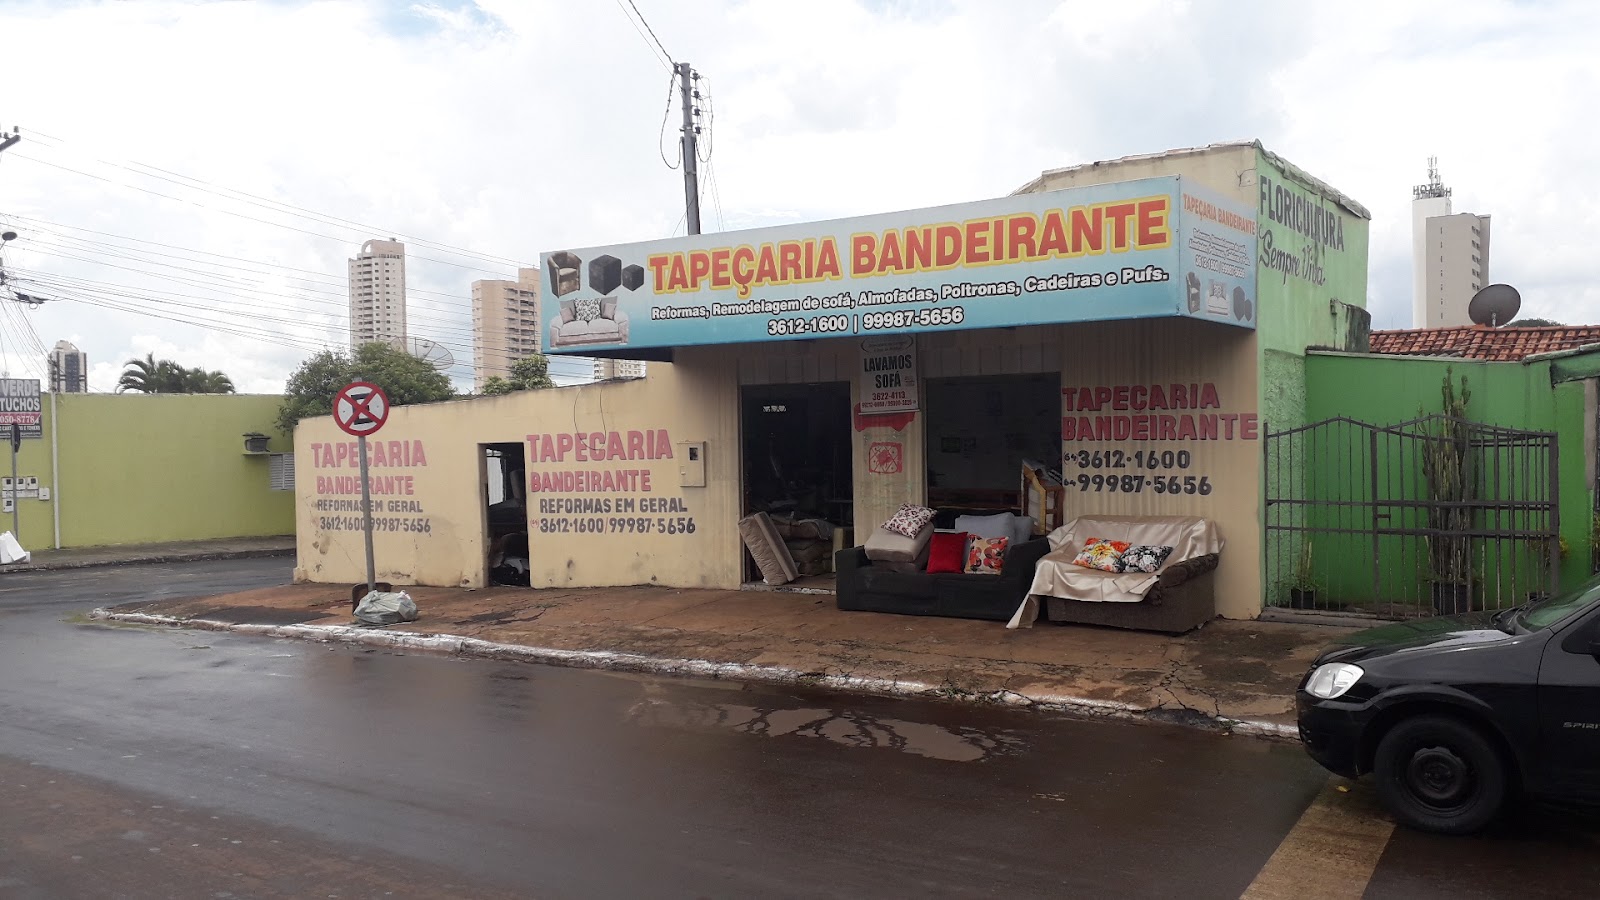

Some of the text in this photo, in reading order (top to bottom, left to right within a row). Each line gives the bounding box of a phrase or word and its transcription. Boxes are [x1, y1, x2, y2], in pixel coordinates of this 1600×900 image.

[1183, 193, 1256, 236] TAPEÇARIA BANDEIRANTE
[1260, 175, 1344, 251] FLORICULTURA
[649, 196, 1169, 298] TAPEÇARIA BANDEIRANTE
[1259, 224, 1300, 285] Sempre
[651, 265, 1169, 320] Reformas, Remodelagem de sofá, Almofadas, Poltronas, Cadeiras e Pufs.
[768, 314, 848, 336] 3612-1600
[863, 305, 964, 331] 99987-5656
[863, 354, 912, 372] LAVAMOS
[1, 380, 39, 396] VERDE
[875, 370, 902, 388] SOFÁ
[0, 397, 40, 412] TUCHOS
[1062, 383, 1221, 413] TAPEÇARIA
[0, 415, 35, 424] 050-8778
[1062, 413, 1259, 441] BANDEIRANTE
[317, 476, 414, 495] BANDERANTE
[530, 469, 652, 492] BANDEIRANTE
[387, 500, 423, 513] GERAL
[540, 497, 688, 514] REFORMAS EM GERAL
